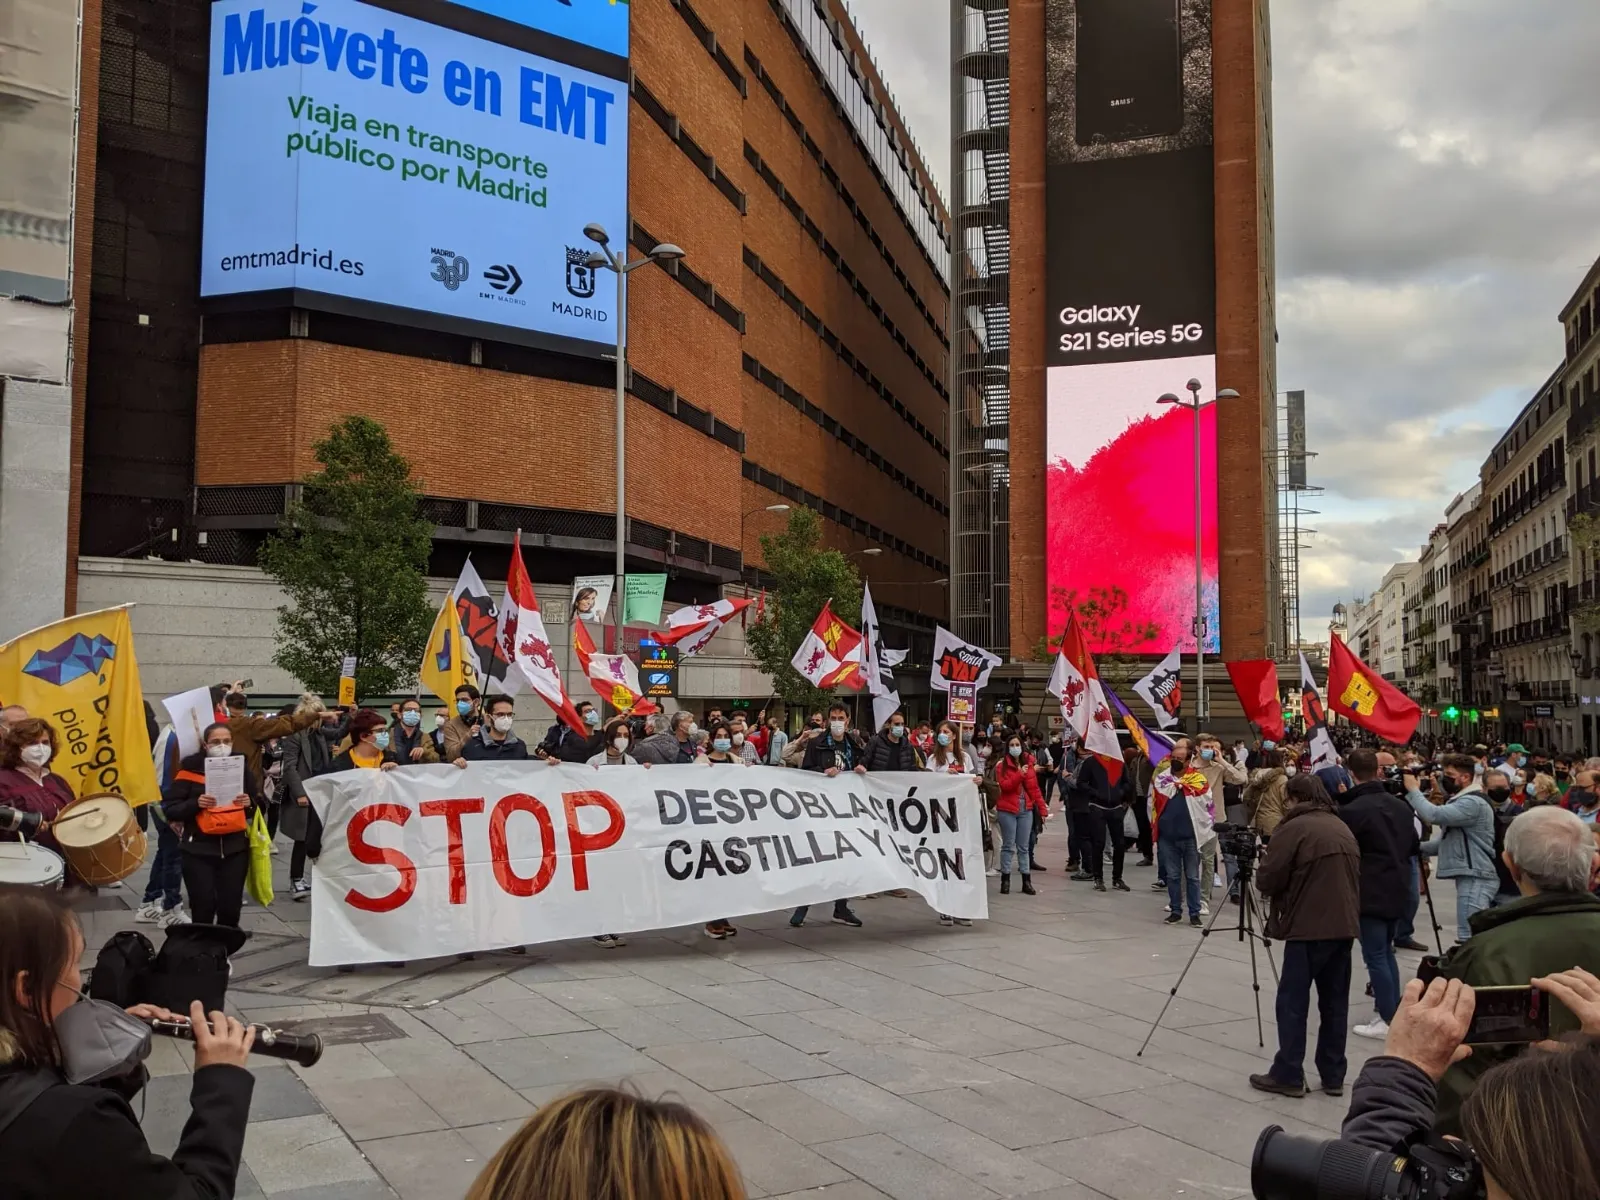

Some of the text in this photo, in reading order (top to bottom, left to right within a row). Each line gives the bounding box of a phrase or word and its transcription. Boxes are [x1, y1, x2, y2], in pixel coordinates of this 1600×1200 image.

[222, 1, 615, 146] Muévete en EMT
[1110, 98, 1135, 107] SAMS
[287, 95, 548, 180] Viaja en transporte
[286, 131, 548, 209] público por Madrid
[220, 243, 364, 278] emtmadrid.es
[430, 247, 456, 259] MADRID
[430, 256, 470, 292] 360
[479, 292, 527, 306] EMT MADRID
[552, 301, 608, 322] MADRID
[1059, 303, 1141, 326] Galaxy
[1059, 323, 1203, 352] S21 Series 5G
[958, 650, 984, 668] SORIA
[53, 707, 89, 755] pide
[656, 785, 959, 834] DESPOBLACIÓN
[344, 789, 626, 914] STOP
[664, 830, 862, 880] CASTILLA
[856, 828, 886, 857] Y
